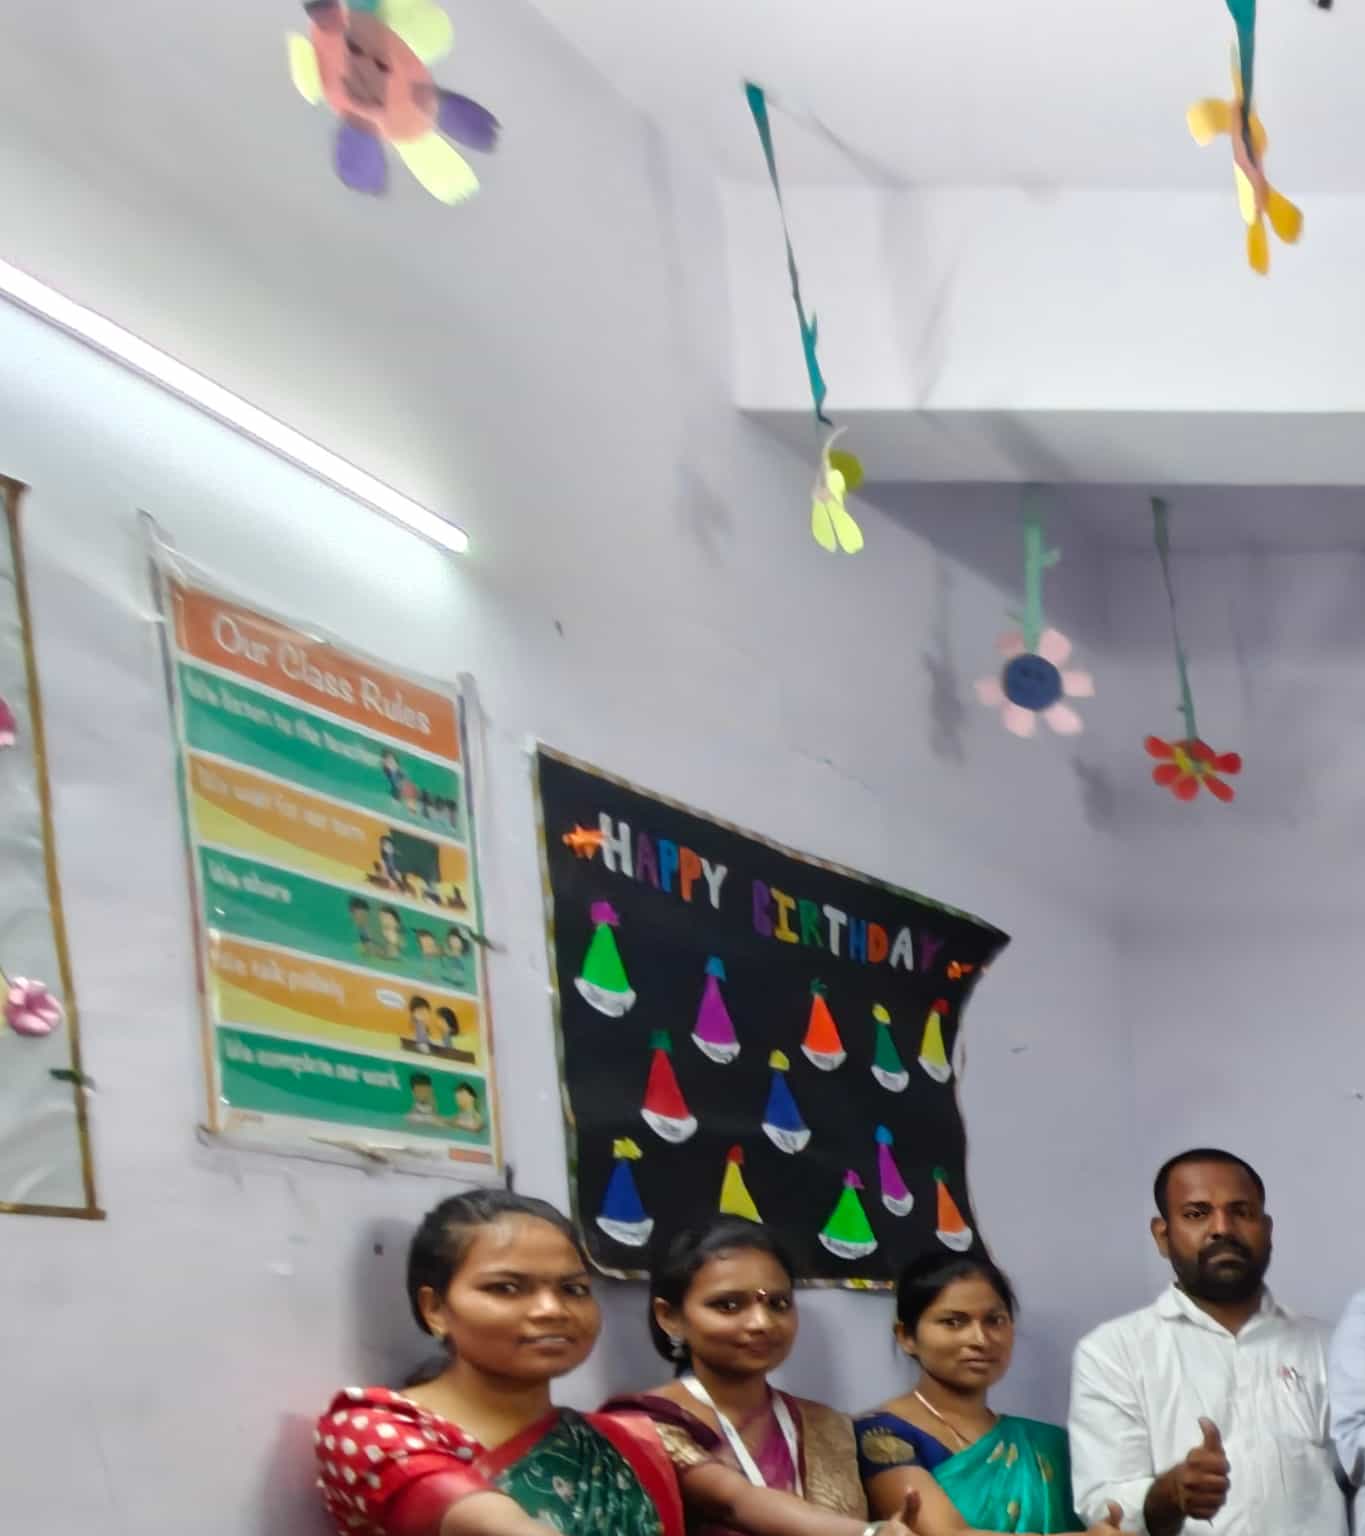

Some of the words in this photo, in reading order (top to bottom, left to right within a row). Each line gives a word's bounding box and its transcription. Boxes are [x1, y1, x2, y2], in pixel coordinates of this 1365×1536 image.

[213, 612, 270, 667] Our
[277, 640, 355, 705] Class
[360, 675, 432, 736] Rules
[598, 812, 728, 910] HAPPY
[752, 879, 945, 975] BIRTHDAY
